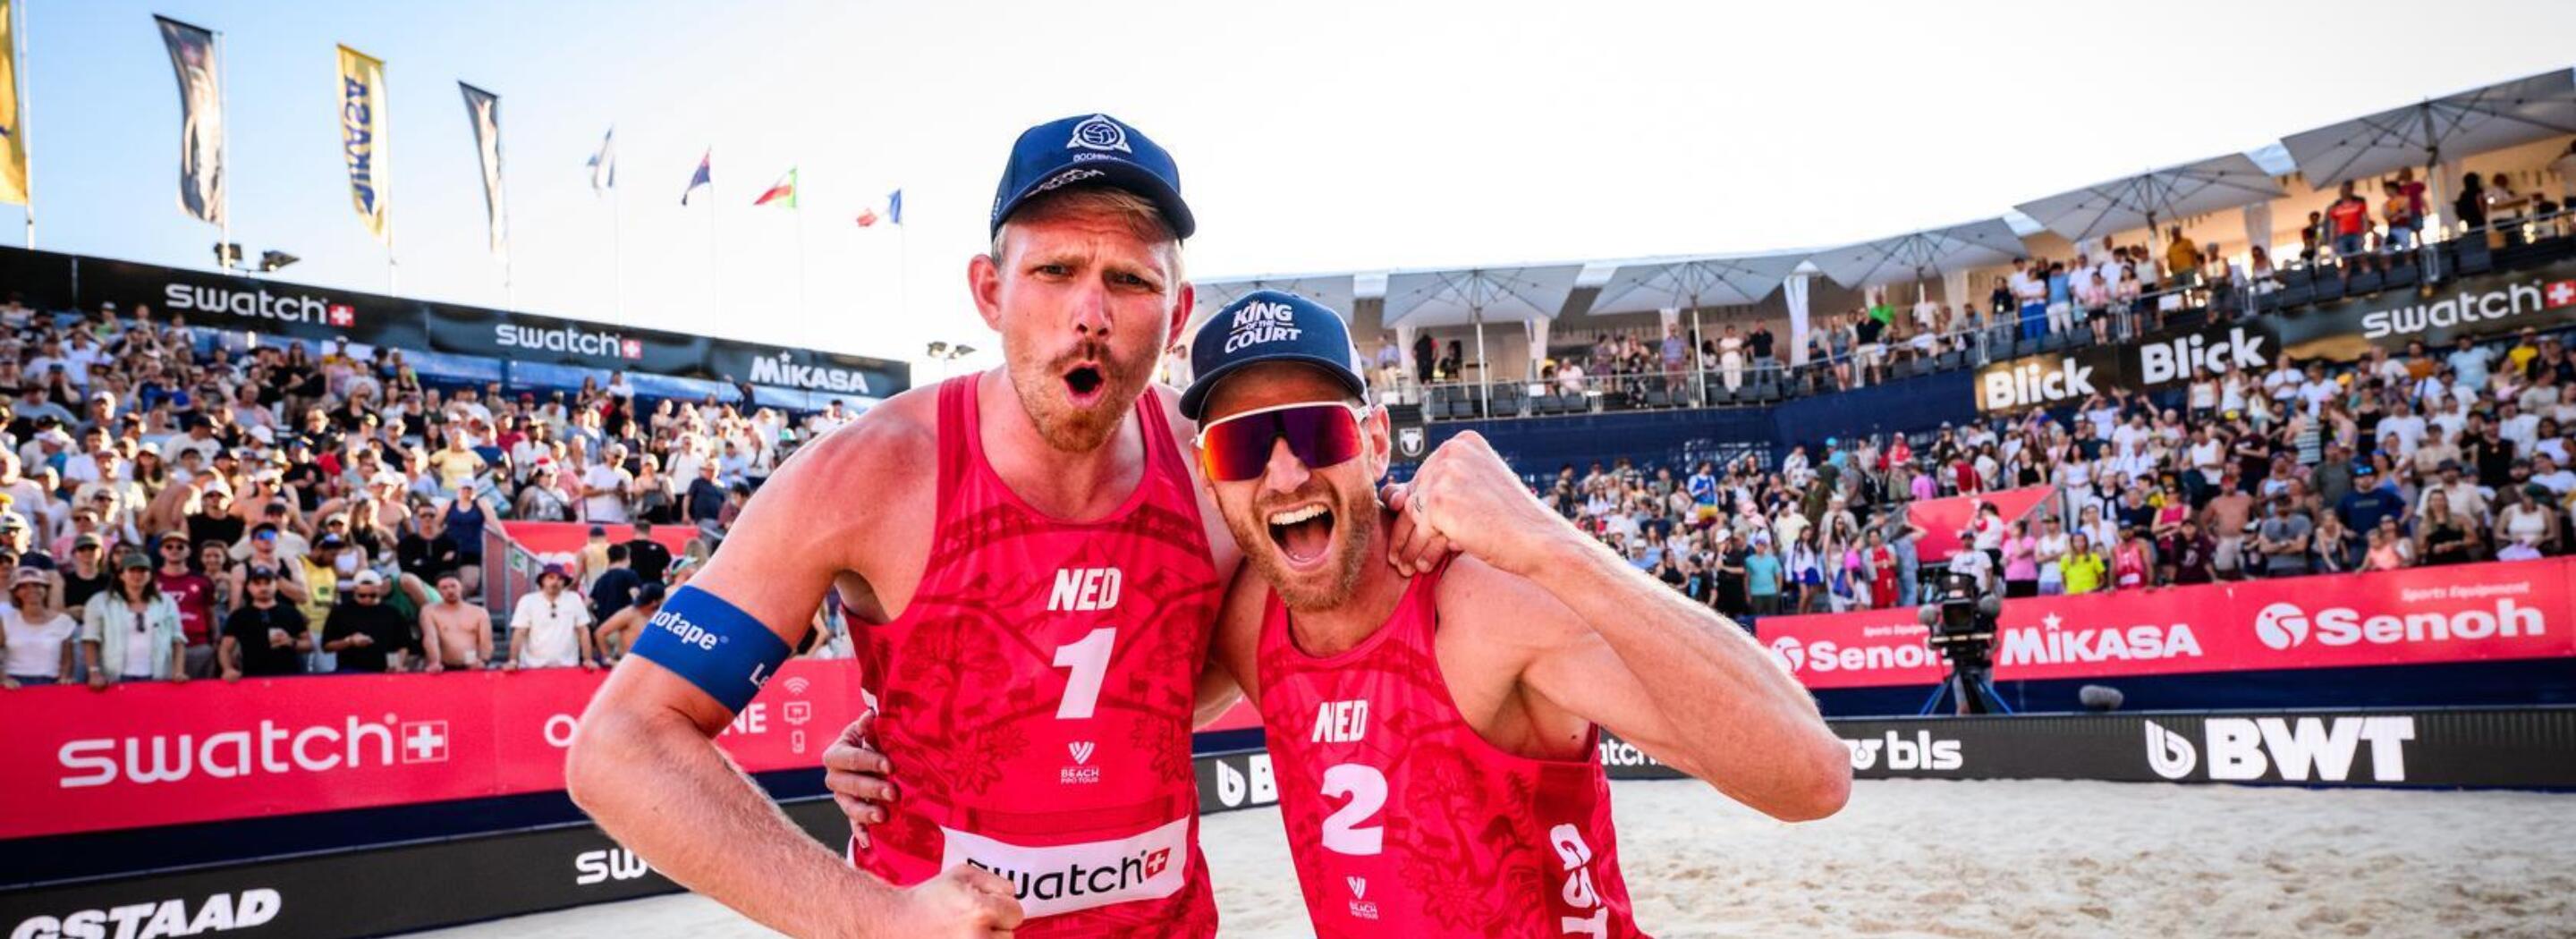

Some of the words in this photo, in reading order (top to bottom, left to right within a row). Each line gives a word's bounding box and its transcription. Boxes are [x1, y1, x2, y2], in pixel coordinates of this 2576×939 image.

[165, 283, 326, 324] swatch
[1233, 300, 1292, 328] KING
[2361, 283, 2543, 339] swatch
[496, 324, 620, 357] swatch
[1224, 326, 1302, 353] COURT
[2140, 327, 2267, 385] Blick
[1985, 358, 2096, 410] Blick
[1047, 567, 1122, 611] NED
[2315, 598, 2546, 646] Senoh
[1053, 627, 1117, 719] 1
[1311, 700, 1368, 742] NED
[58, 715, 394, 788] swatch
[1885, 730, 1963, 770] bls
[2205, 716, 2415, 782] BWT
[1320, 763, 1388, 856] 2
